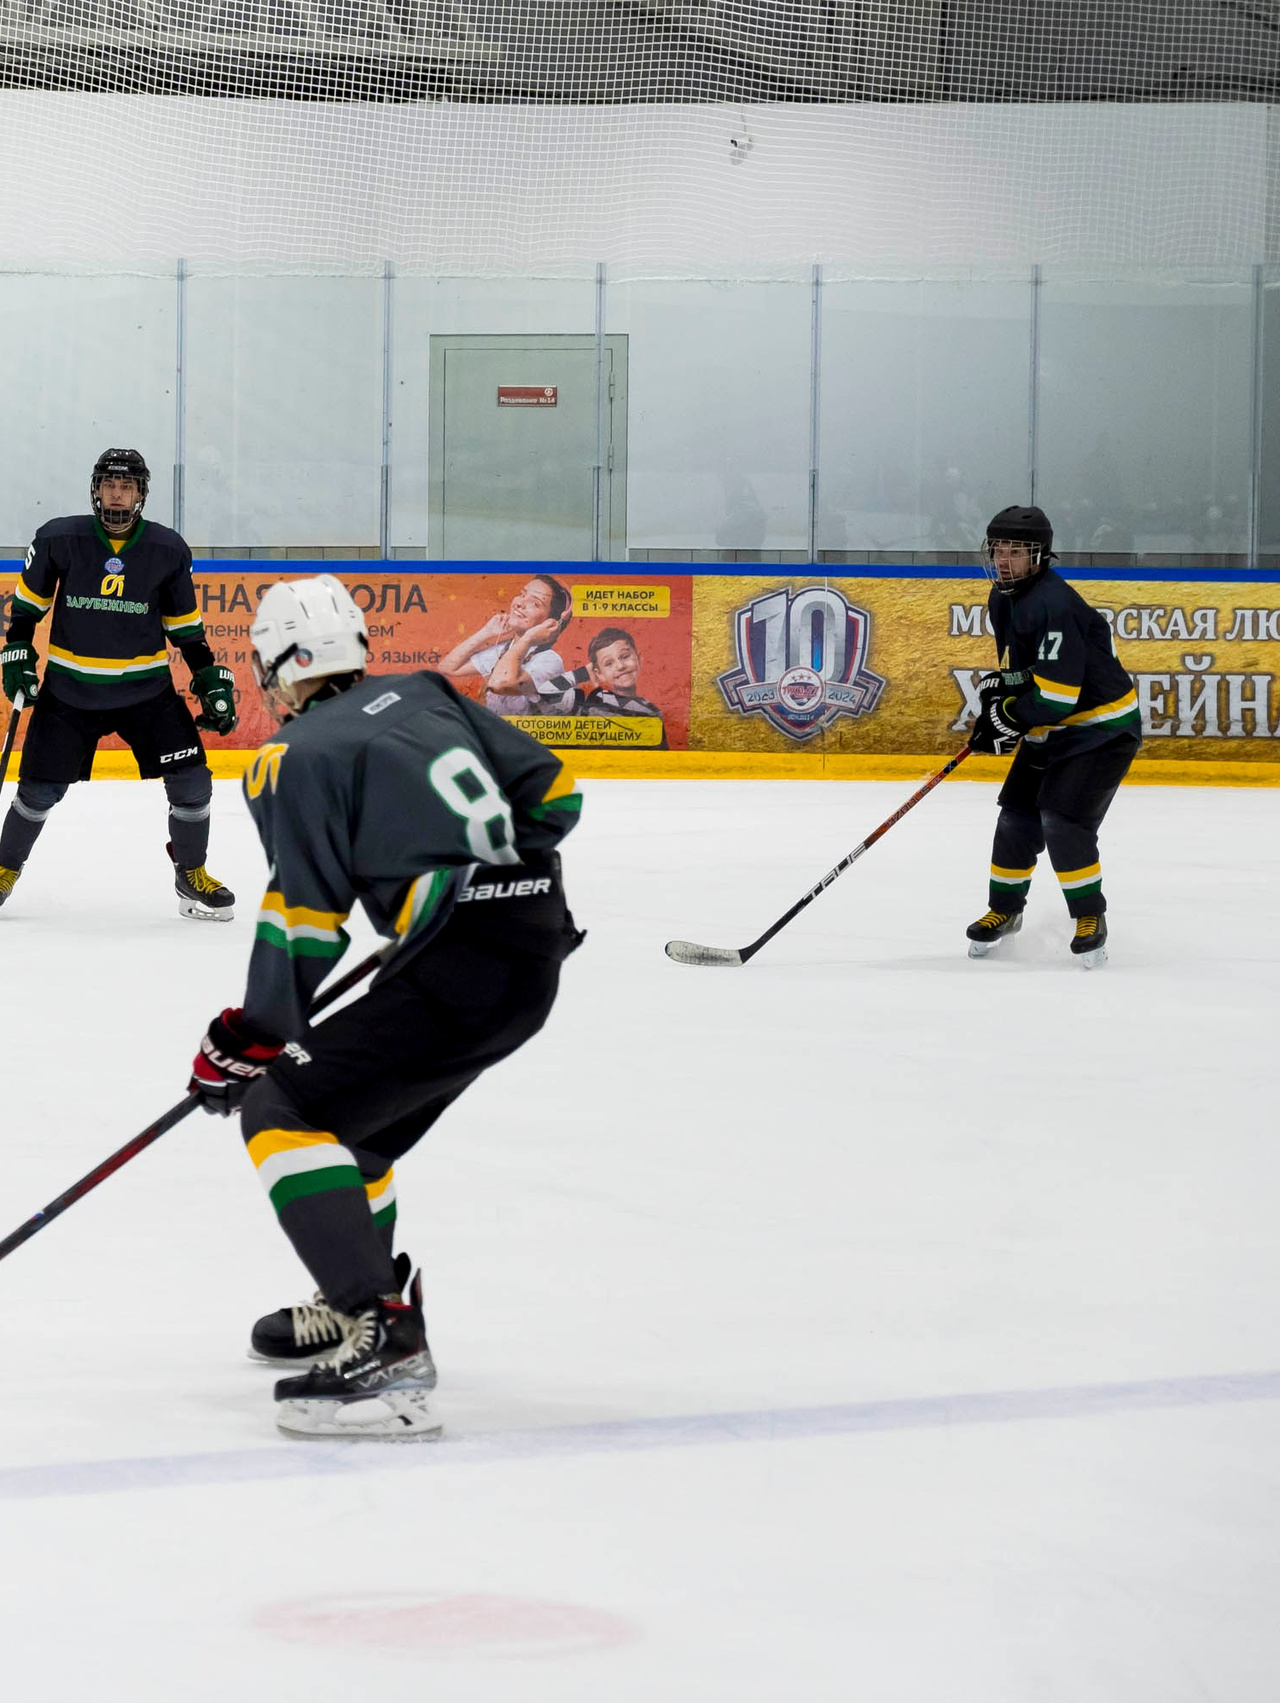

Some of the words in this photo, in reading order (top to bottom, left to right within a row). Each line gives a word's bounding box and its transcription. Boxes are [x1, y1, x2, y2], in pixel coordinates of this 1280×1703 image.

[586, 590, 614, 600] ИДЕТ
[617, 590, 655, 600] НАБОР
[582, 602, 589, 611] В
[593, 602, 609, 611] 1-9
[611, 602, 658, 612] КЛАССЫ
[752, 588, 847, 683] 10
[516, 719, 571, 730] ГОТОВИМ
[574, 717, 612, 731] ДЕТЕЙ
[575, 730, 643, 742] БУДУЩЕМУ
[159, 745, 199, 764] CCM
[428, 746, 523, 866] 8
[457, 876, 552, 903] BAUER
